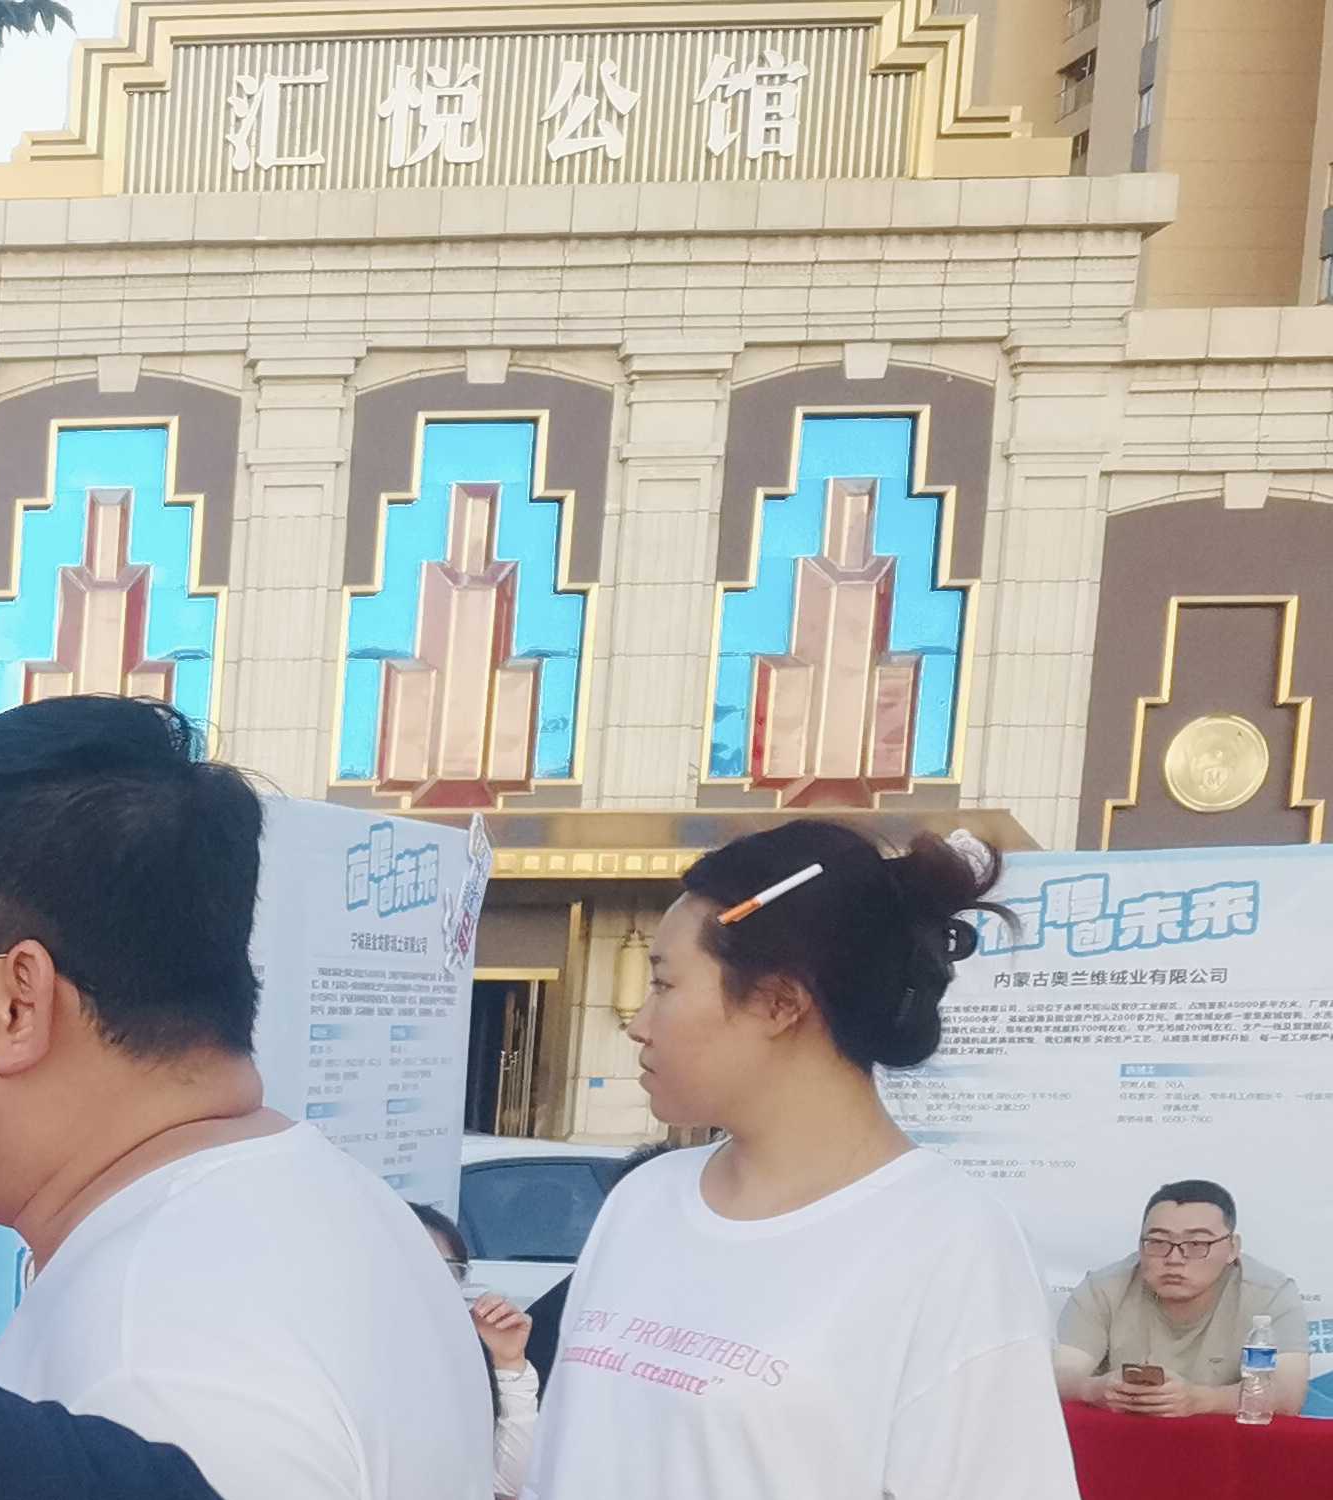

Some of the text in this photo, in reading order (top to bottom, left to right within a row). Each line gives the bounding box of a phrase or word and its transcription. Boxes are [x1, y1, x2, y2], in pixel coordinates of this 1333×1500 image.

[228, 47, 809, 173] 汇悦公馆
[993, 967, 1228, 990] 内蒙古奥兰维绒业有限公司
[619, 1317, 789, 1387] PROMETHEUS
